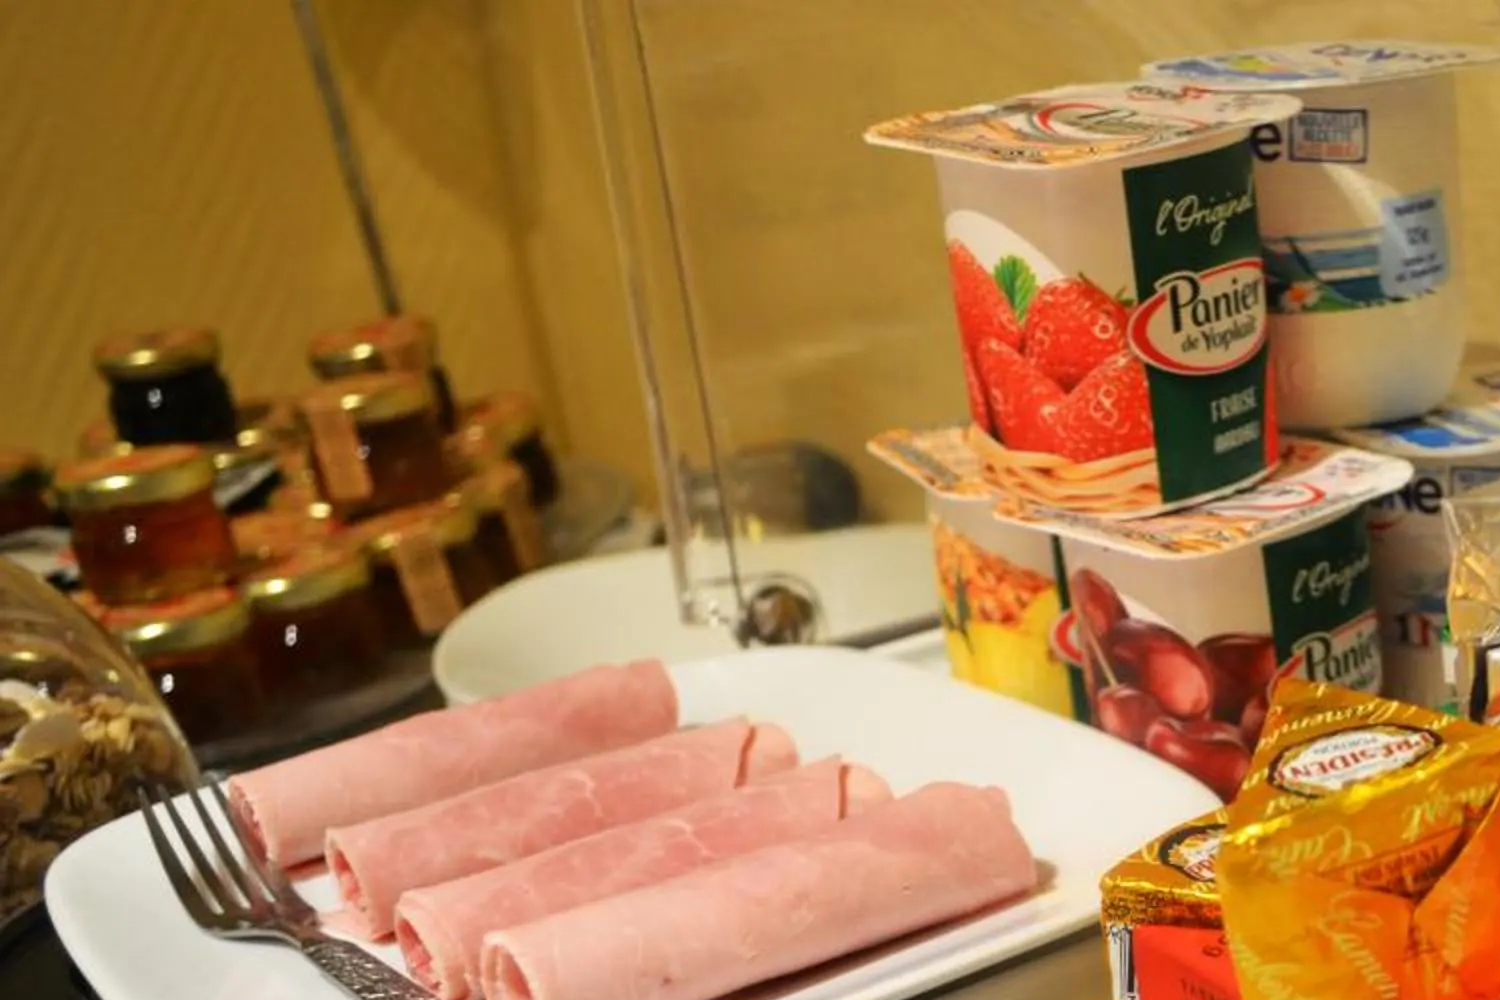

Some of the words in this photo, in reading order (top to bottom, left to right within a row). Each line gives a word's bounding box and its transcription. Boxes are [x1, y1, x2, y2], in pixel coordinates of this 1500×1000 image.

[1160, 275, 1263, 334] Panier
[1181, 335, 1199, 353] de
[1201, 316, 1258, 352] Yoplait
